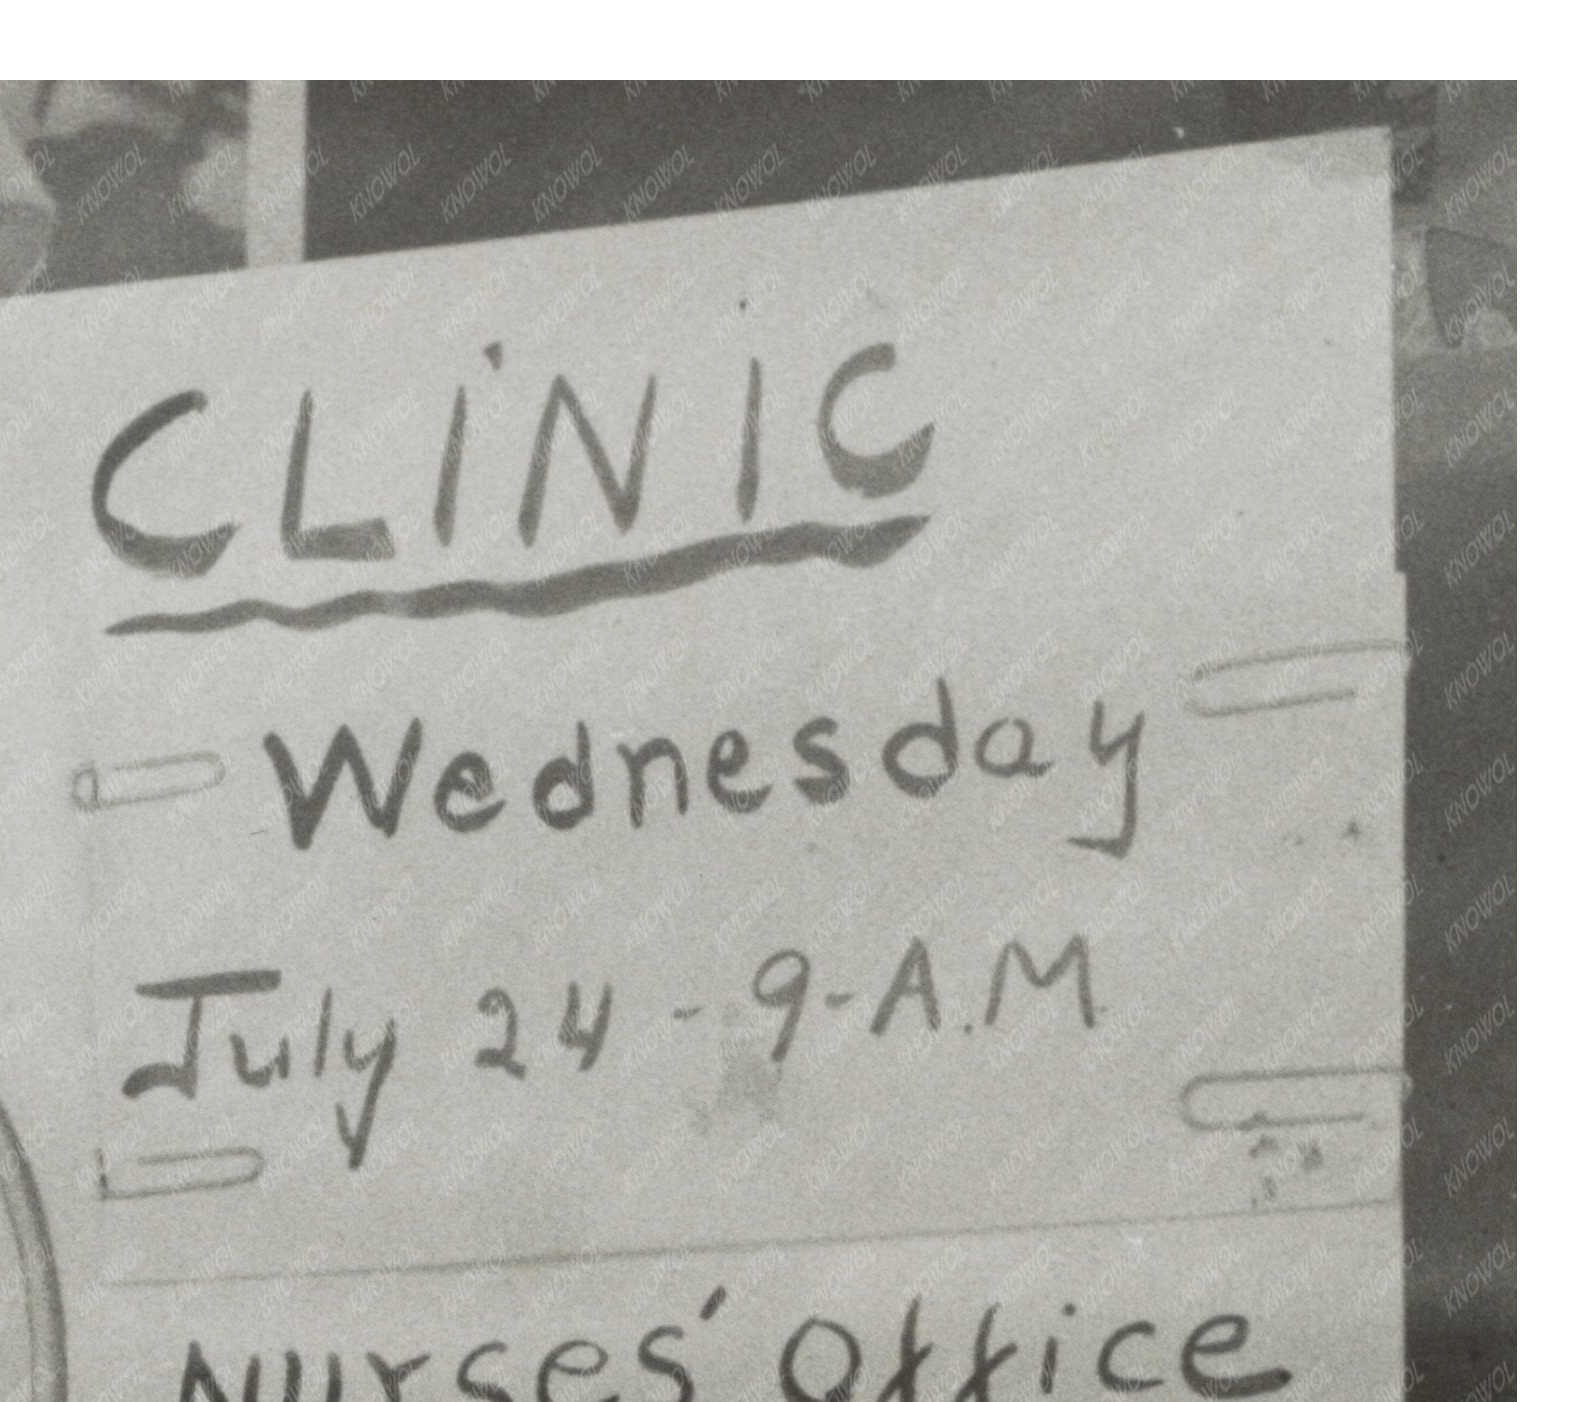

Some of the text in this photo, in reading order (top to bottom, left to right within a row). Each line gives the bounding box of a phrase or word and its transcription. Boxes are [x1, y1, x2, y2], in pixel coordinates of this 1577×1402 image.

[261, 678, 1145, 860] Wednesday
[119, 966, 399, 1169] July
[473, 983, 615, 1081] 24
